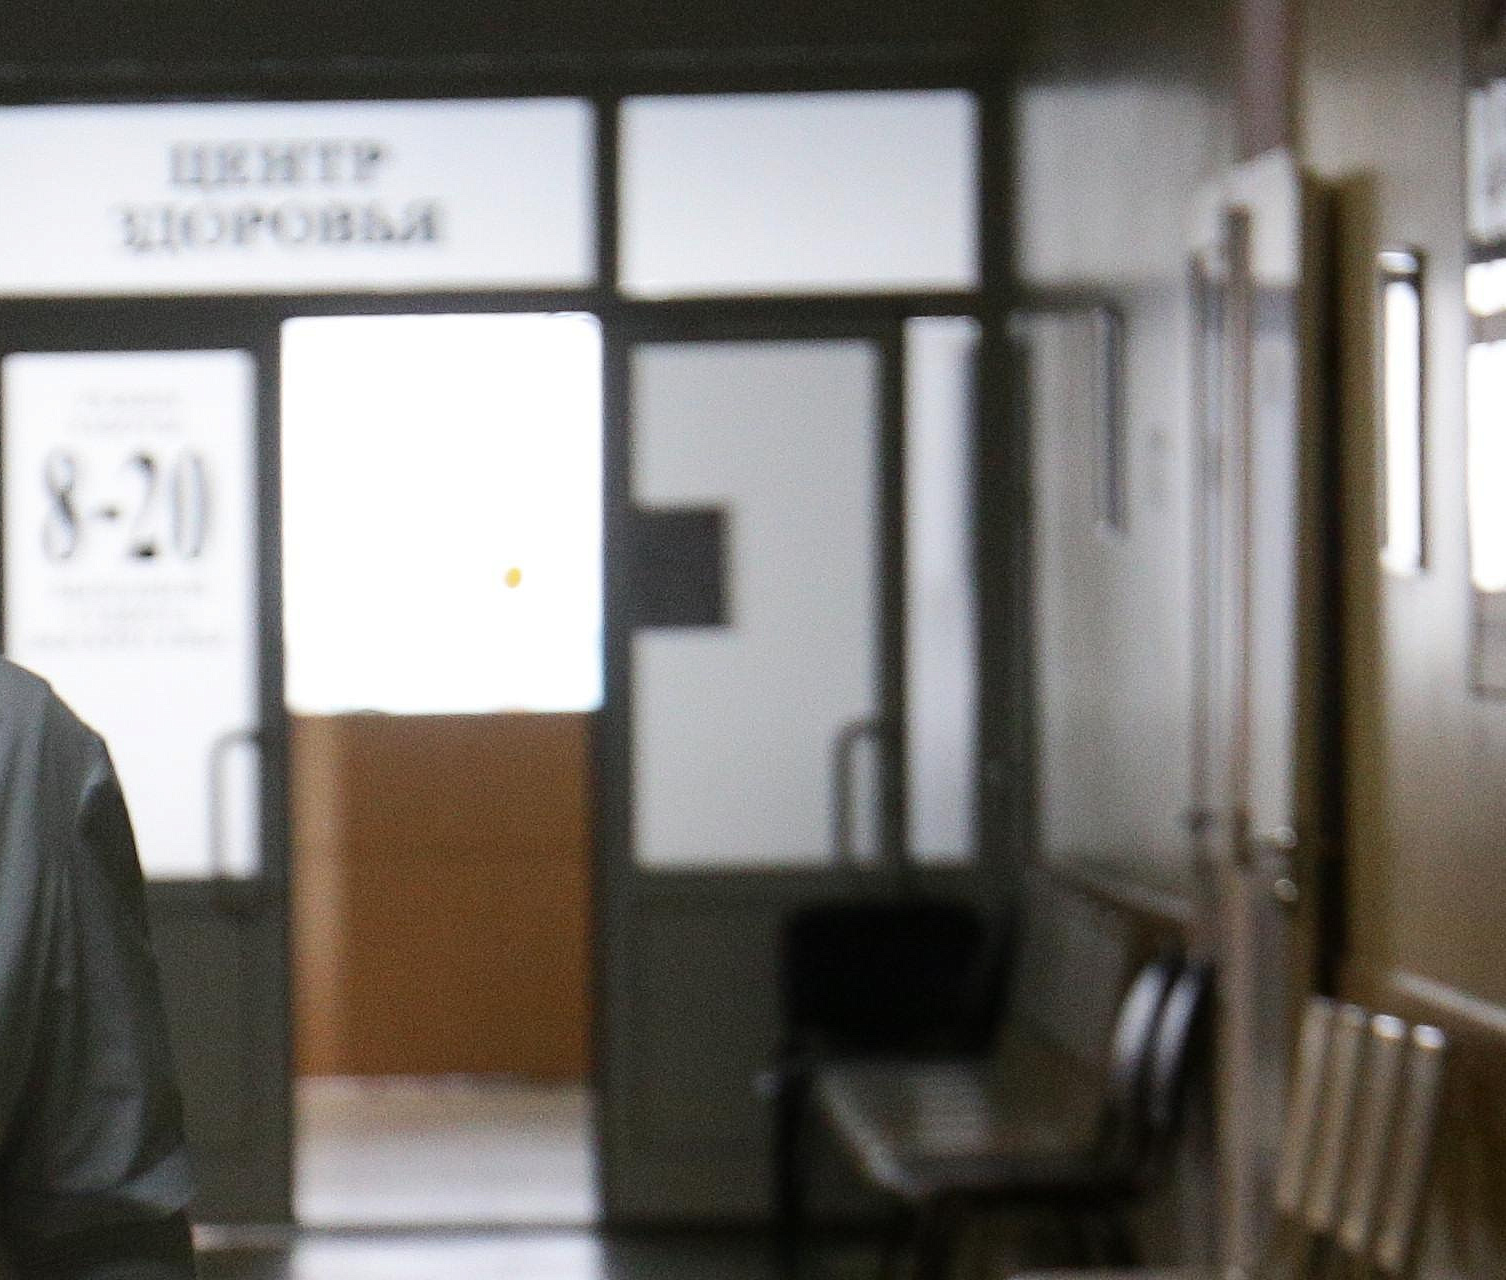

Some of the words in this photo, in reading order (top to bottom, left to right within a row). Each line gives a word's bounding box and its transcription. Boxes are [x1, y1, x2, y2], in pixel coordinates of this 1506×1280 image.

[168, 139, 386, 188] ЦЕНТР
[120, 202, 440, 255] ЗДОРОВЬЯ
[42, 447, 211, 564] 8-20
